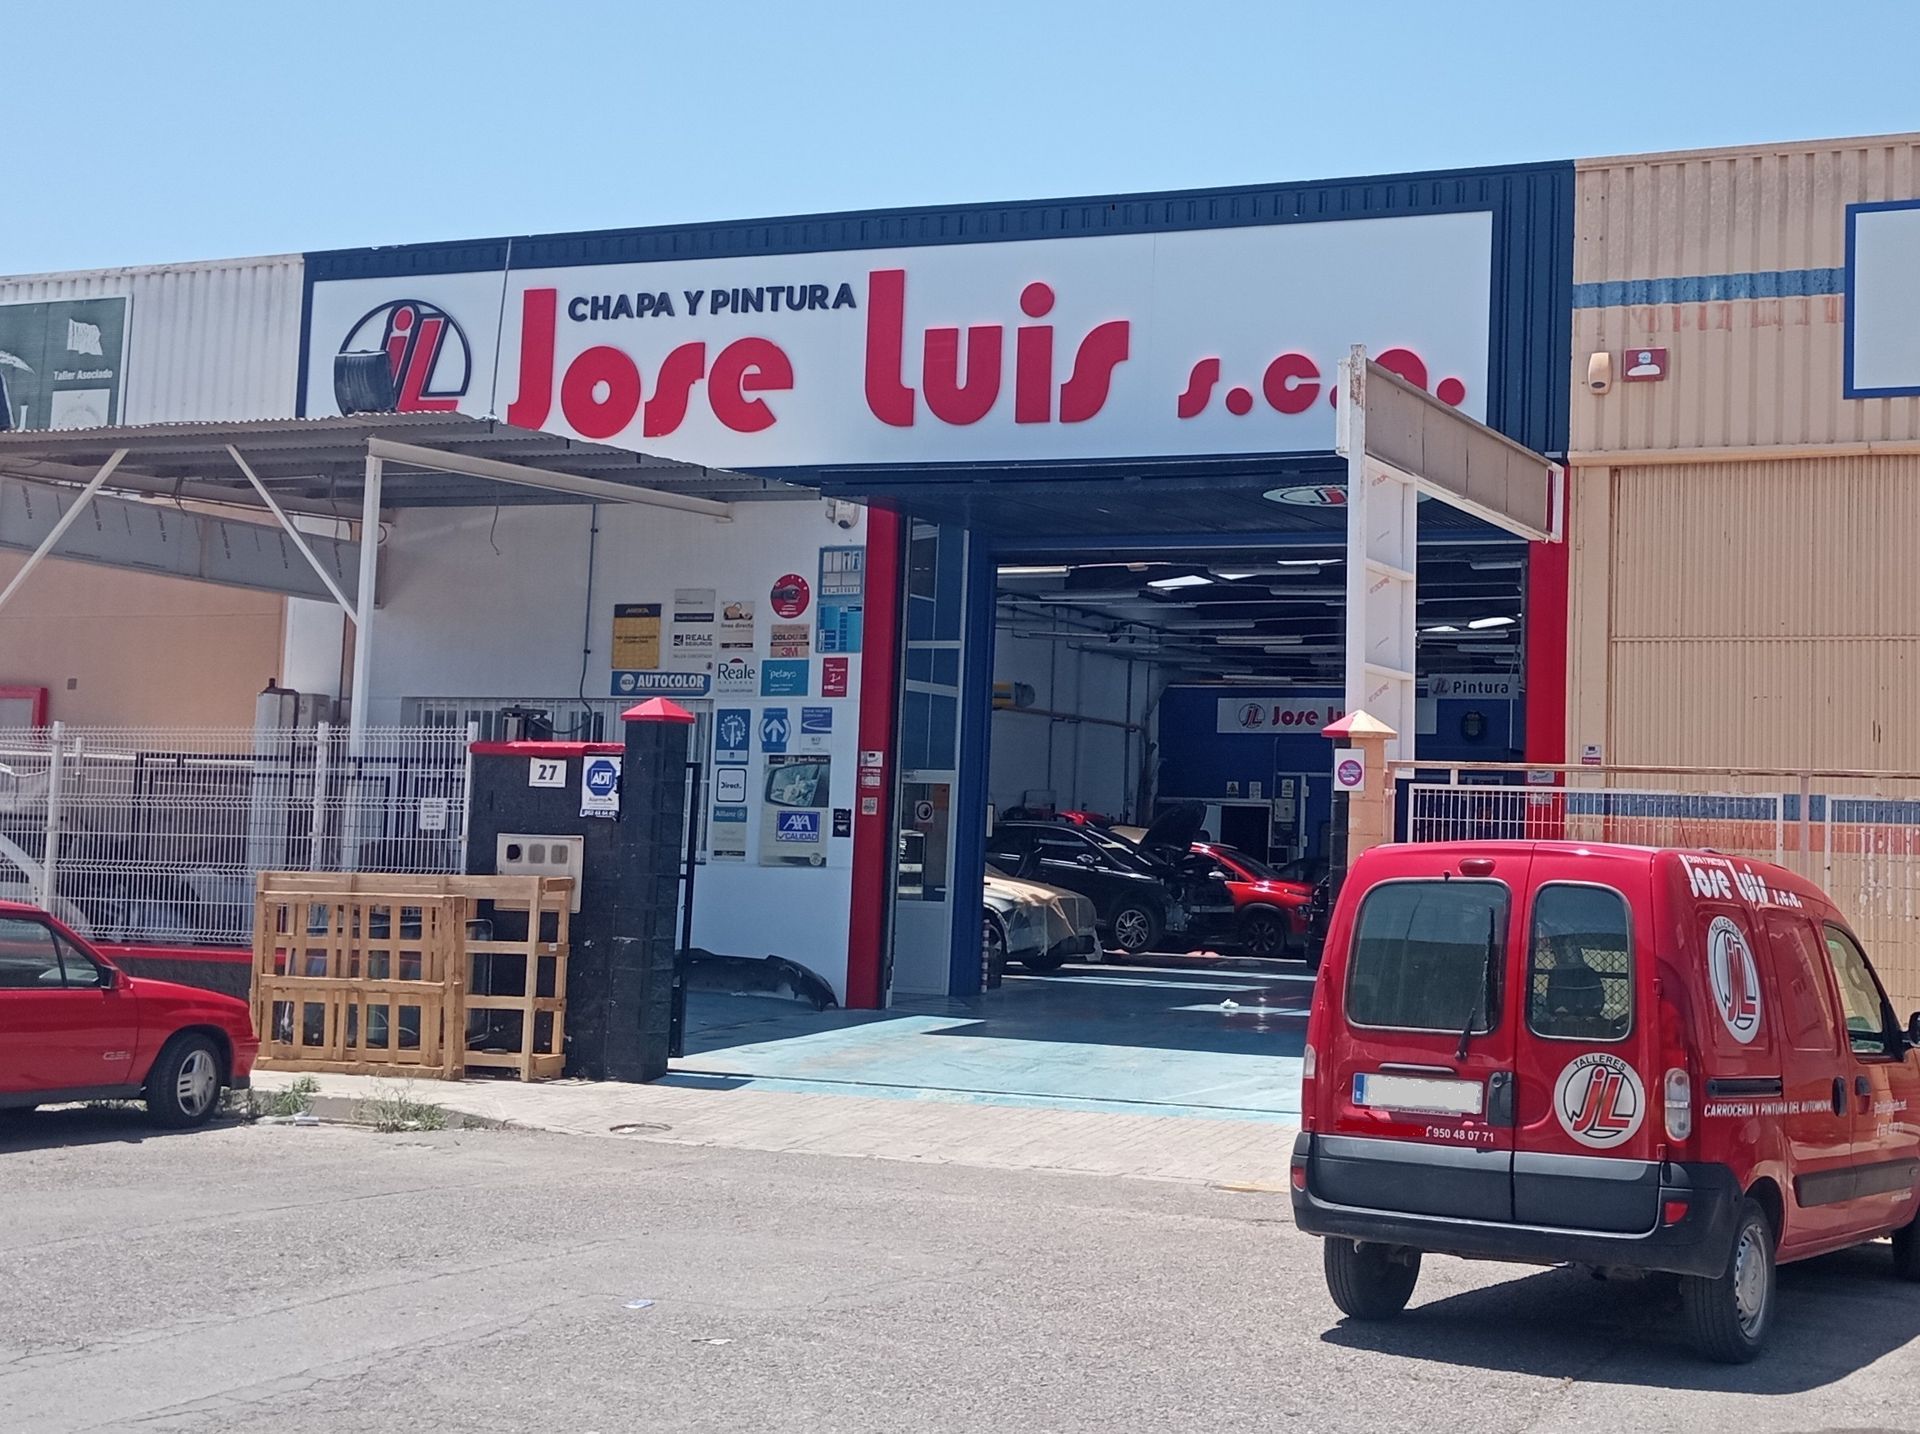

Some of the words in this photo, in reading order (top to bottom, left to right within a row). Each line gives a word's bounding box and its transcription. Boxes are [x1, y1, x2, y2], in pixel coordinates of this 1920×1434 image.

[568, 290, 675, 322] CHAPA
[683, 290, 706, 316] Y
[709, 282, 857, 316] PINTURA
[507, 287, 794, 439] Jose
[53, 370, 76, 381] Taller
[76, 368, 113, 380] Asociado
[781, 647, 798, 657] 3M
[717, 663, 756, 680] Reale
[637, 674, 705, 689] AUTOCOLOR
[1453, 680, 1509, 694] Pintura
[1272, 706, 1319, 726] Jose
[537, 764, 558, 781] 27
[591, 771, 612, 785] ADT
[783, 815, 812, 831] AXA
[785, 832, 817, 840] CALIDAD
[1573, 1054, 1627, 1071] TALLERES
[1704, 1103, 1754, 1118] CARROCERIA
[1755, 1103, 1761, 1115] Y
[1761, 1102, 1788, 1115] PINTURA
[1789, 1101, 1800, 1114] DEL
[1433, 1128, 1451, 1139] 950
[1453, 1130, 1466, 1140] 48
[1468, 1131, 1480, 1141] 07
[1482, 1131, 1494, 1142] 71
